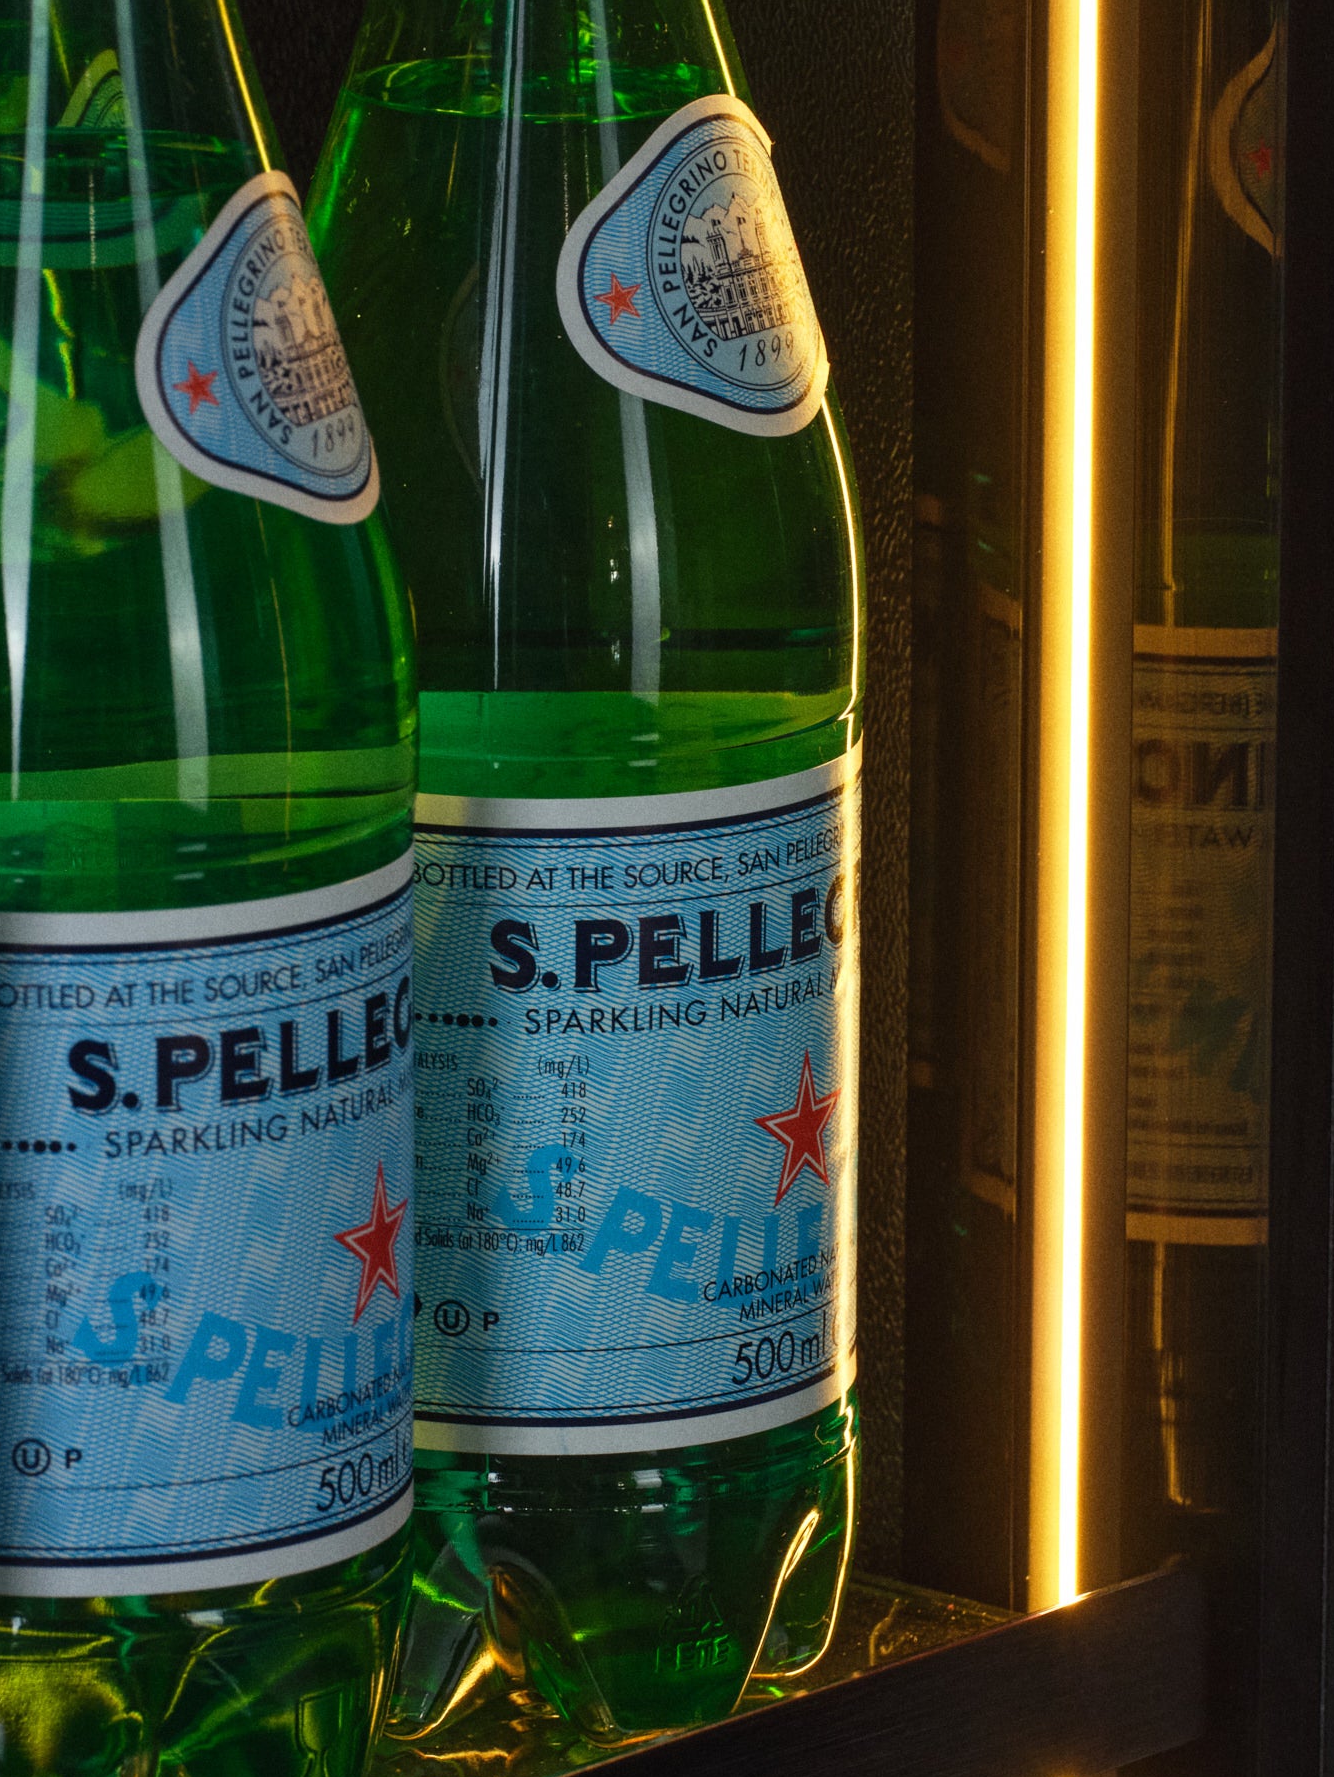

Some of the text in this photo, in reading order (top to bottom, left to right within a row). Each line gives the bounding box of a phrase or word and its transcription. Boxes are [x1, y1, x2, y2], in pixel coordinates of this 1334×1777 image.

[656, 149, 729, 359] SAN PELLEGRINO
[231, 228, 294, 447] SAN PELLEGRINO
[739, 329, 796, 372] 1899
[525, 867, 556, 891] AT
[569, 866, 615, 891] THE
[624, 855, 730, 889] SOURCE,
[737, 844, 781, 877] SAN
[104, 983, 135, 1009] AT
[147, 979, 195, 1006] THE
[204, 963, 308, 1002] SOURCE,
[315, 950, 357, 979] SAN
[524, 971, 824, 1036] SPARKLING NATURAL
[536, 1055, 591, 1078] (mg/L)
[560, 1081, 587, 1100] 418
[104, 1084, 395, 1161] SPARKLING NATURAL
[560, 1106, 587, 1125] 252
[562, 1130, 587, 1150] 174
[554, 1155, 587, 1174] 49.6
[554, 1180, 587, 1199] 48.7
[554, 1205, 587, 1224] 31.0
[423, 1226, 454, 1249] Solids
[525, 1234, 559, 1256] mg/L
[561, 1232, 585, 1253] 862
[703, 1254, 818, 1302] CARBONATED
[482, 1312, 501, 1332] P
[739, 1286, 810, 1322] MINERAL
[287, 1370, 393, 1428] CARBONATED
[322, 1402, 389, 1447] MINERAL
[64, 1449, 83, 1470] P
